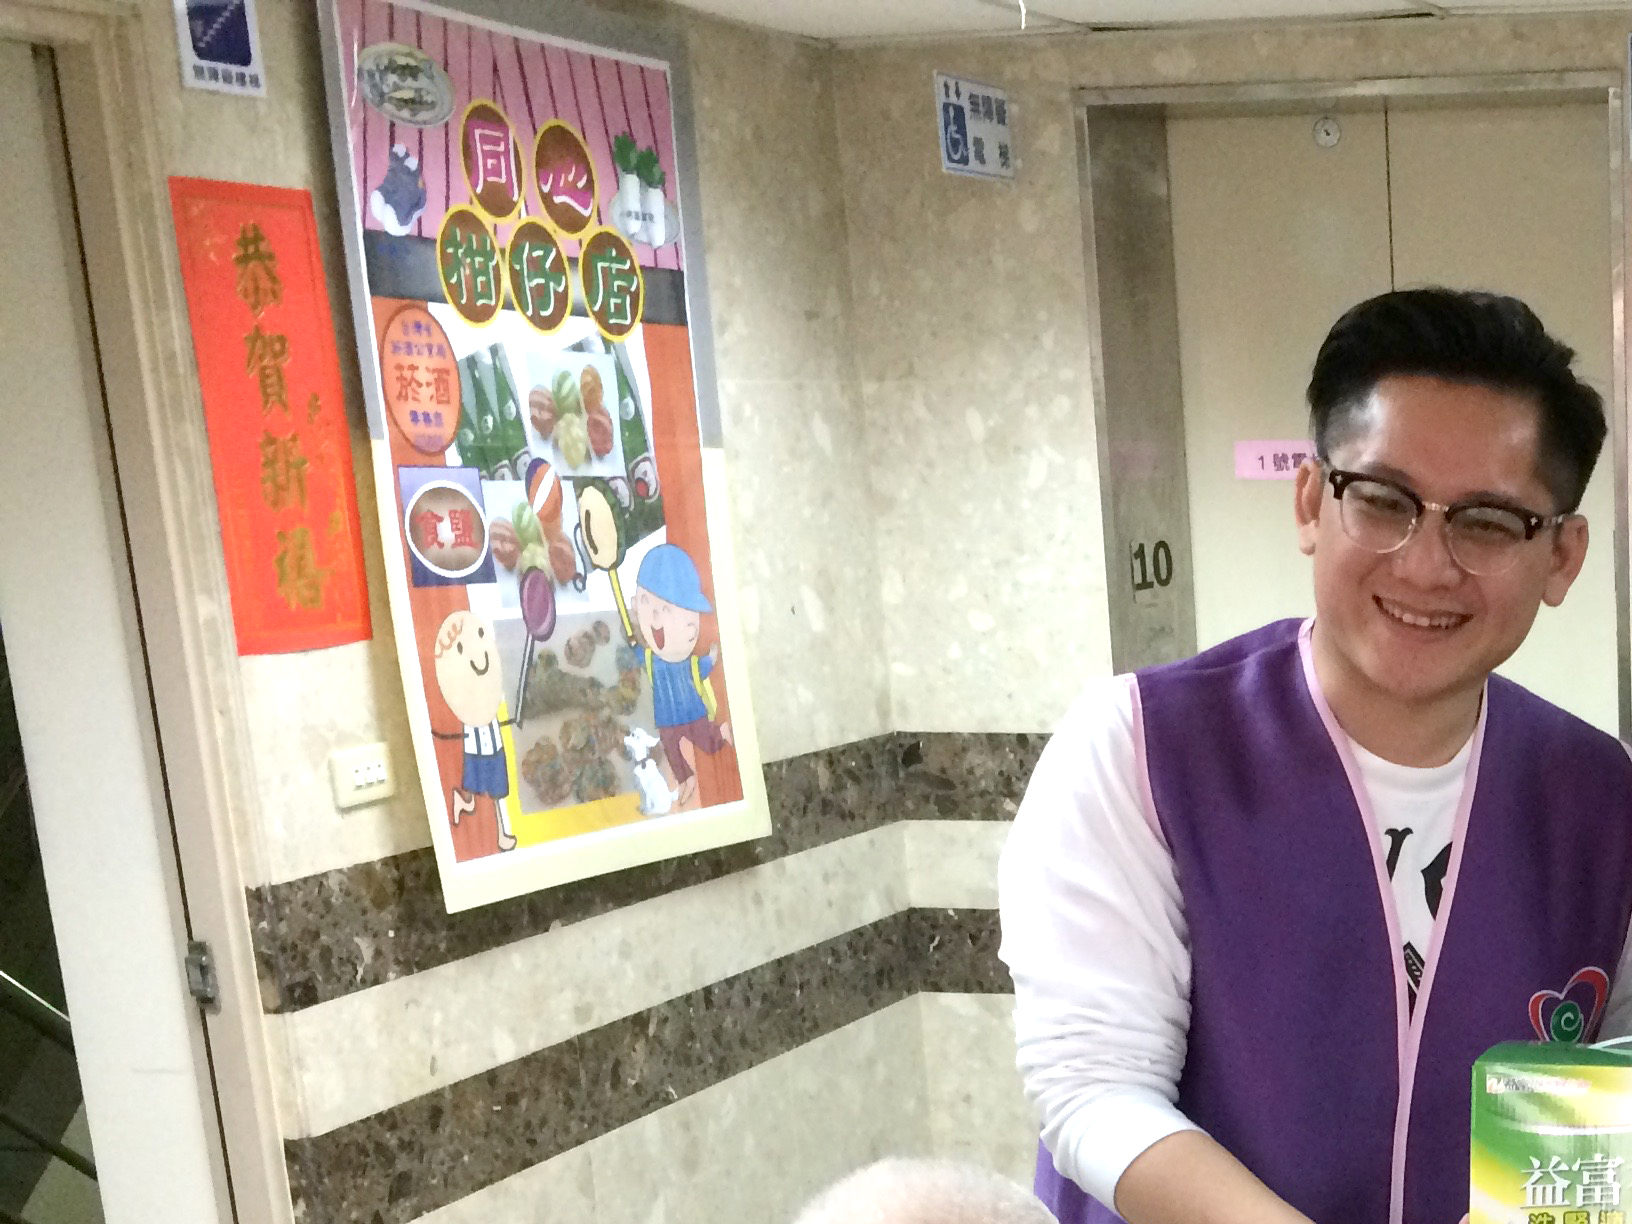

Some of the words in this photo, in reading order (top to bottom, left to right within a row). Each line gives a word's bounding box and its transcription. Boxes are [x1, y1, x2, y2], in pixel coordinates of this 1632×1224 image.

[443, 224, 638, 325] 柑仔店
[1133, 540, 1173, 591] 10
